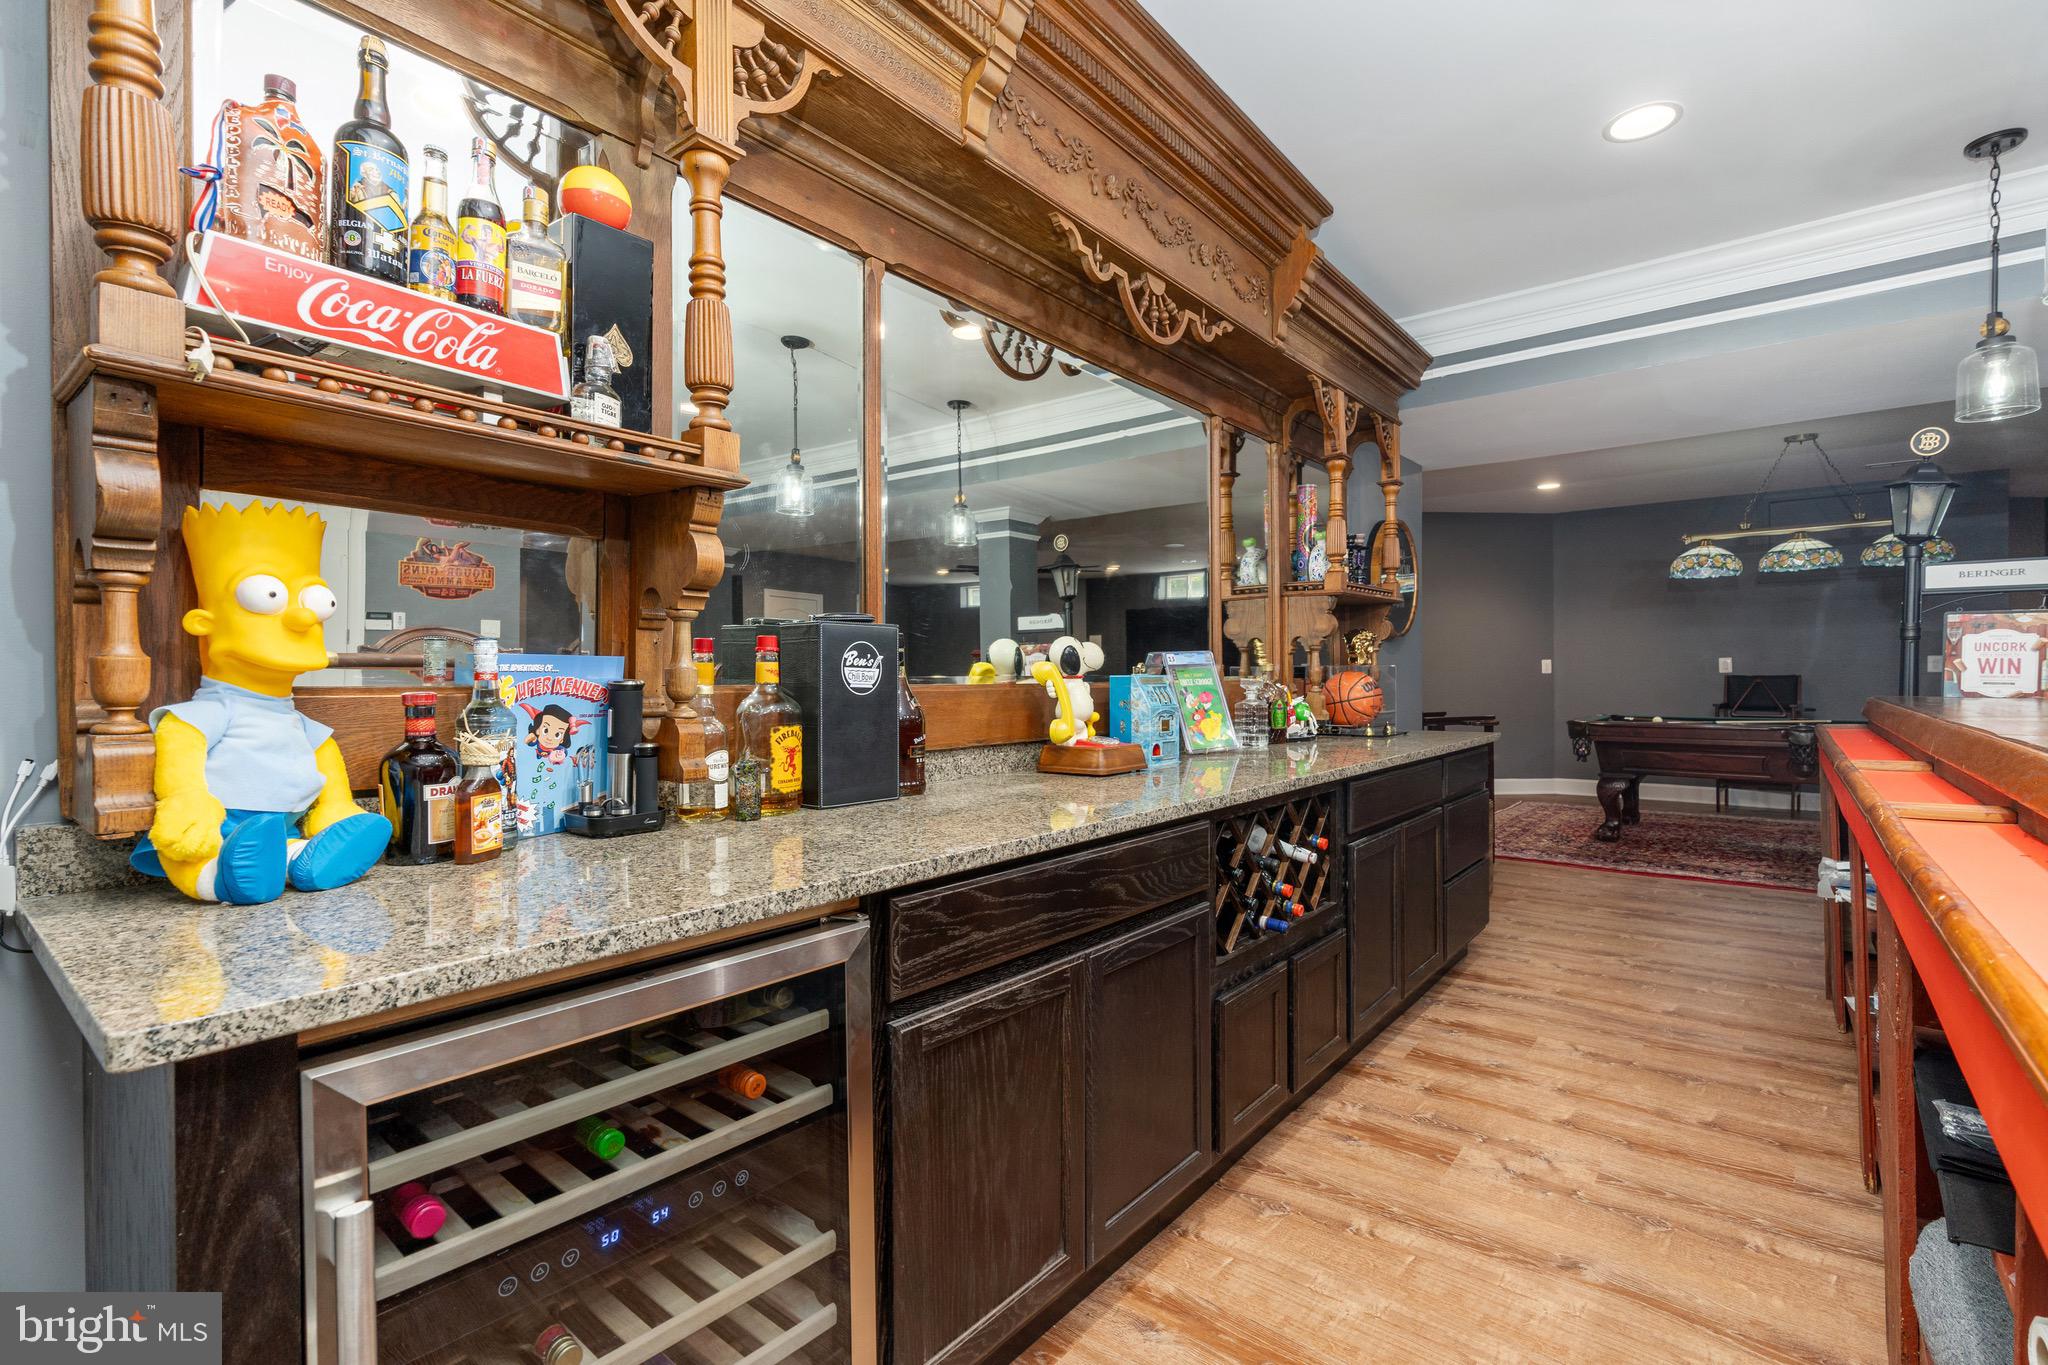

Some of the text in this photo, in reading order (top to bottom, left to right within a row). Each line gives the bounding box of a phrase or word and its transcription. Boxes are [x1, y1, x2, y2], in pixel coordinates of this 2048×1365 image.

[265, 197, 292, 212] READY
[338, 219, 374, 230] BELGIAN
[422, 227, 455, 245] Corona
[264, 255, 314, 285] Enjoy
[461, 268, 473, 280] LA
[520, 282, 555, 295] DORADO
[297, 276, 505, 371] Coca-Cola
[601, 402, 613, 411] OJO
[601, 408, 617, 418] TIGRE
[1958, 568, 2027, 578] BERINGER
[1974, 641, 2027, 652] UNCORK
[844, 650, 873, 667] Ben's
[1978, 658, 2022, 675] WIN
[847, 671, 876, 681] Chili Bowl
[499, 674, 552, 709] SUPER
[652, 1207, 669, 1224] 54
[601, 1229, 620, 1247] 50
